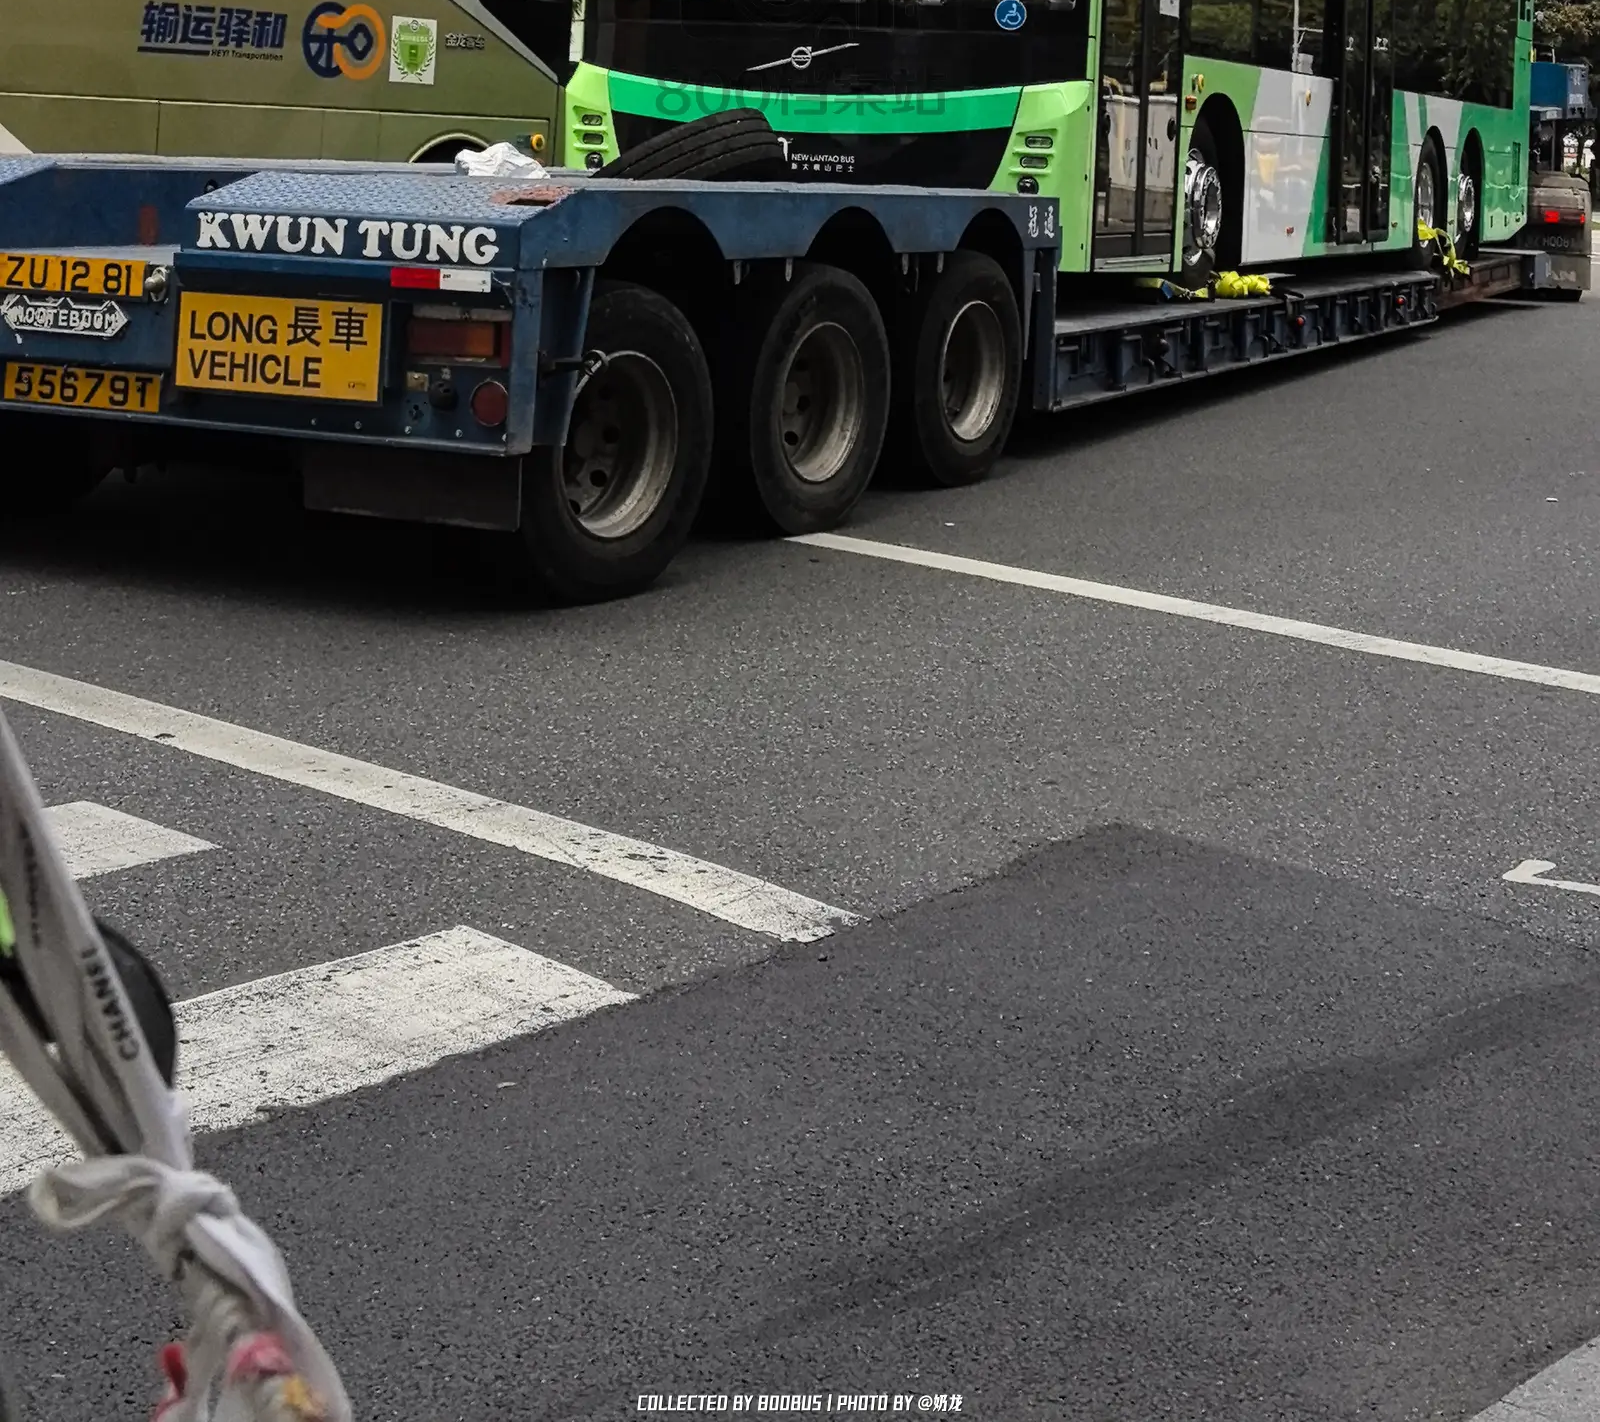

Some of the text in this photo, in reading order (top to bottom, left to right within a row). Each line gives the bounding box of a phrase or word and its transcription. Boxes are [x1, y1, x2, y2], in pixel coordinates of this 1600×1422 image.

[791, 153, 855, 163] NEW LANTAO BUS
[196, 211, 500, 265] KWUN TUNG
[13, 305, 118, 332] NOOTEBOOM
[189, 305, 369, 352] LONG 長車
[14, 366, 154, 408] 55679T
[188, 348, 323, 389] VEHICLE
